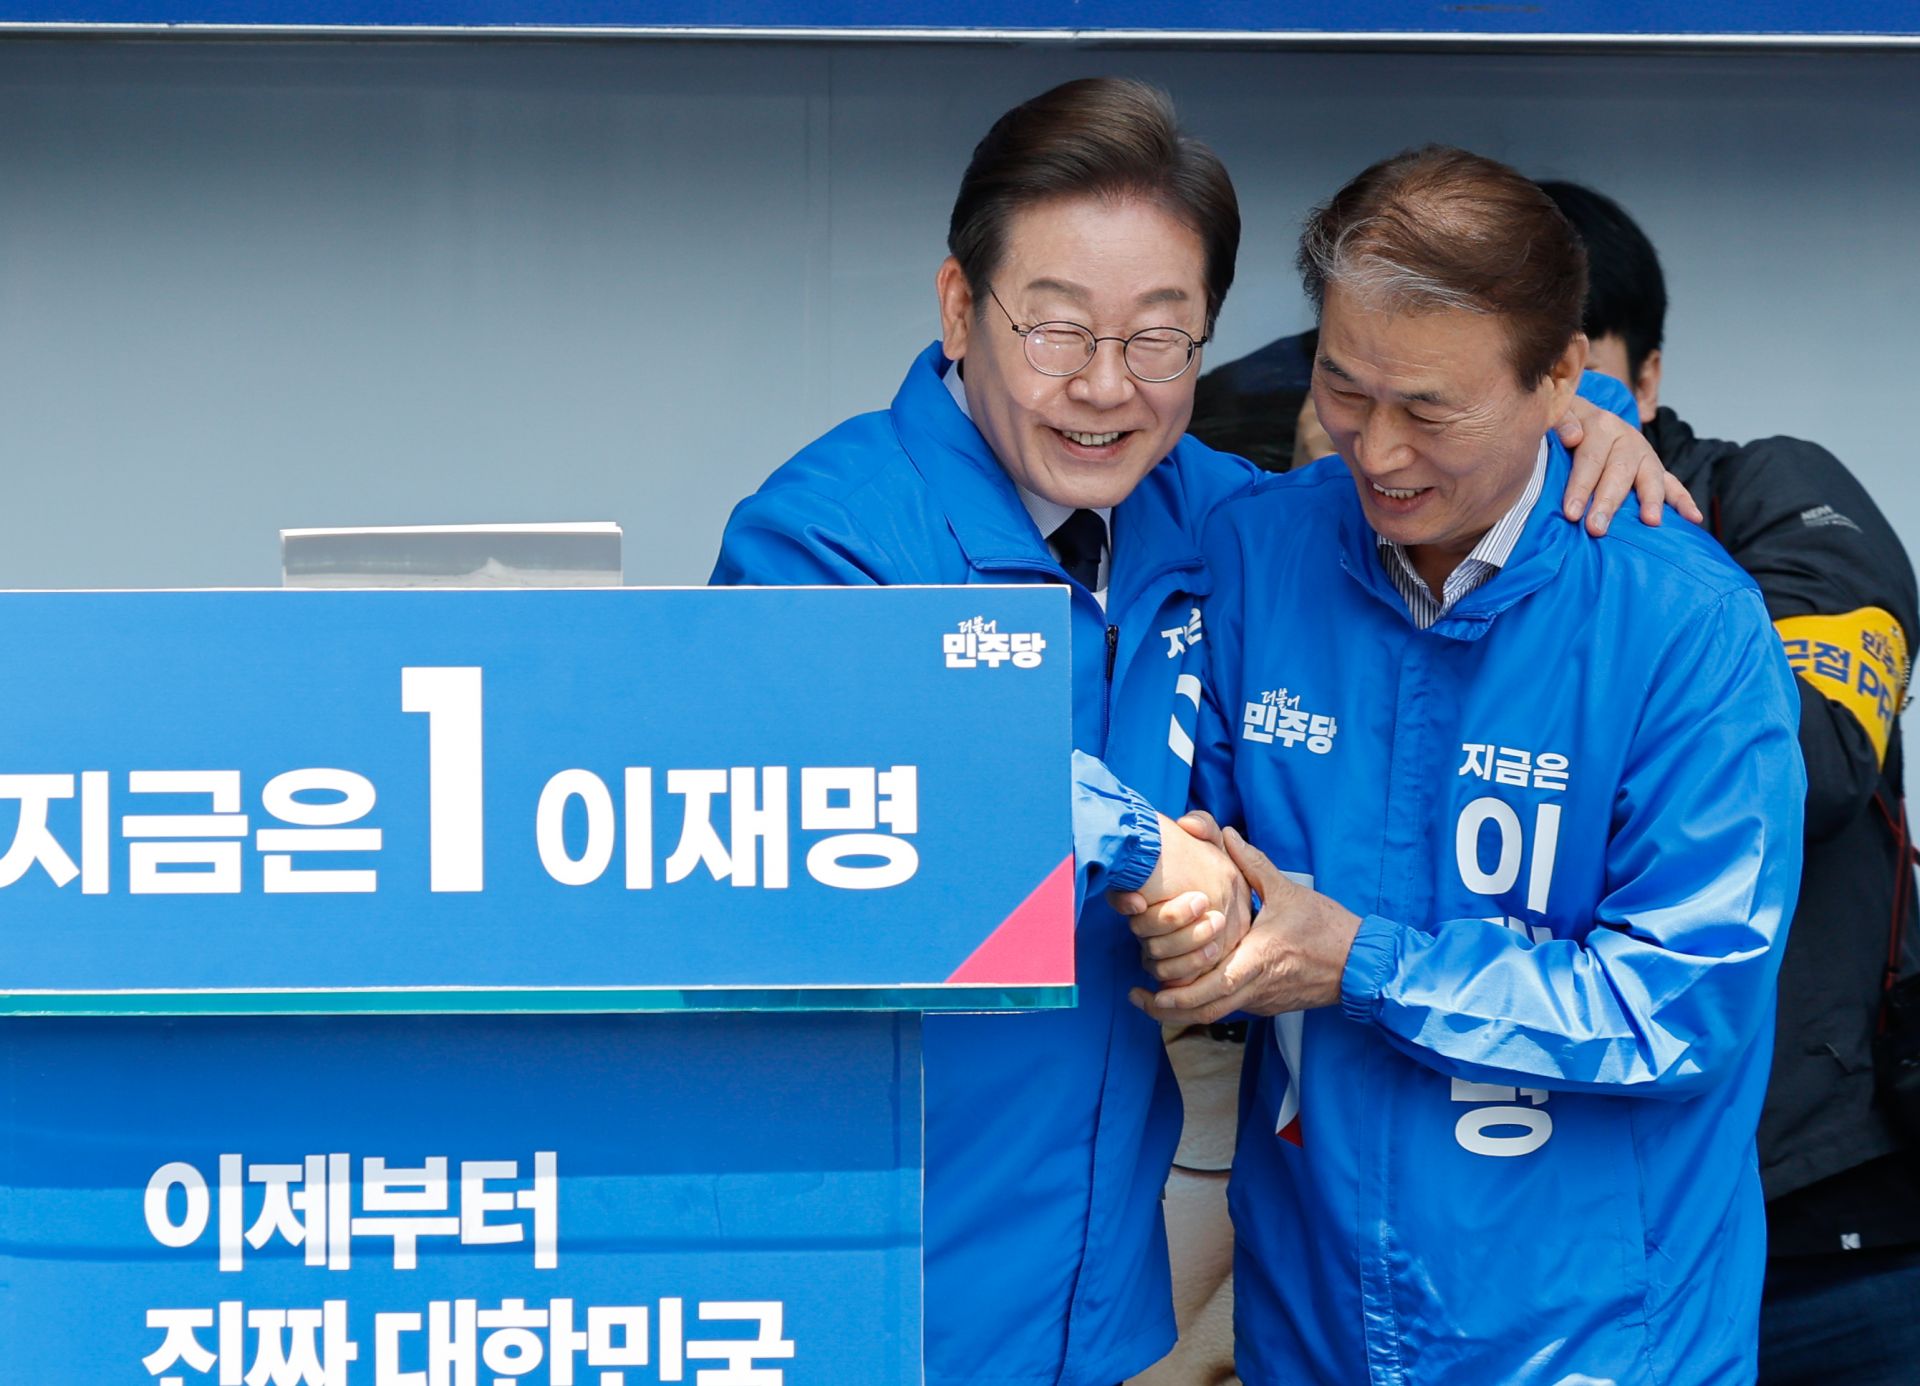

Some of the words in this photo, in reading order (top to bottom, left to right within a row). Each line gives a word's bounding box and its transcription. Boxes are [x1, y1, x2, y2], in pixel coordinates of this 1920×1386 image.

[943, 632, 1047, 668] 민주당
[957, 615, 997, 636] 더불어
[1261, 688, 1301, 711] 더불어
[1243, 701, 1338, 755] 민주당
[0, 767, 381, 895] 지금은
[401, 667, 484, 892] 1
[536, 765, 919, 890] 이재명
[1458, 743, 1570, 791] 지금은
[144, 1151, 558, 1272] 이제부터
[142, 1300, 358, 1386] 진짜
[375, 1297, 795, 1386] 대한민국
